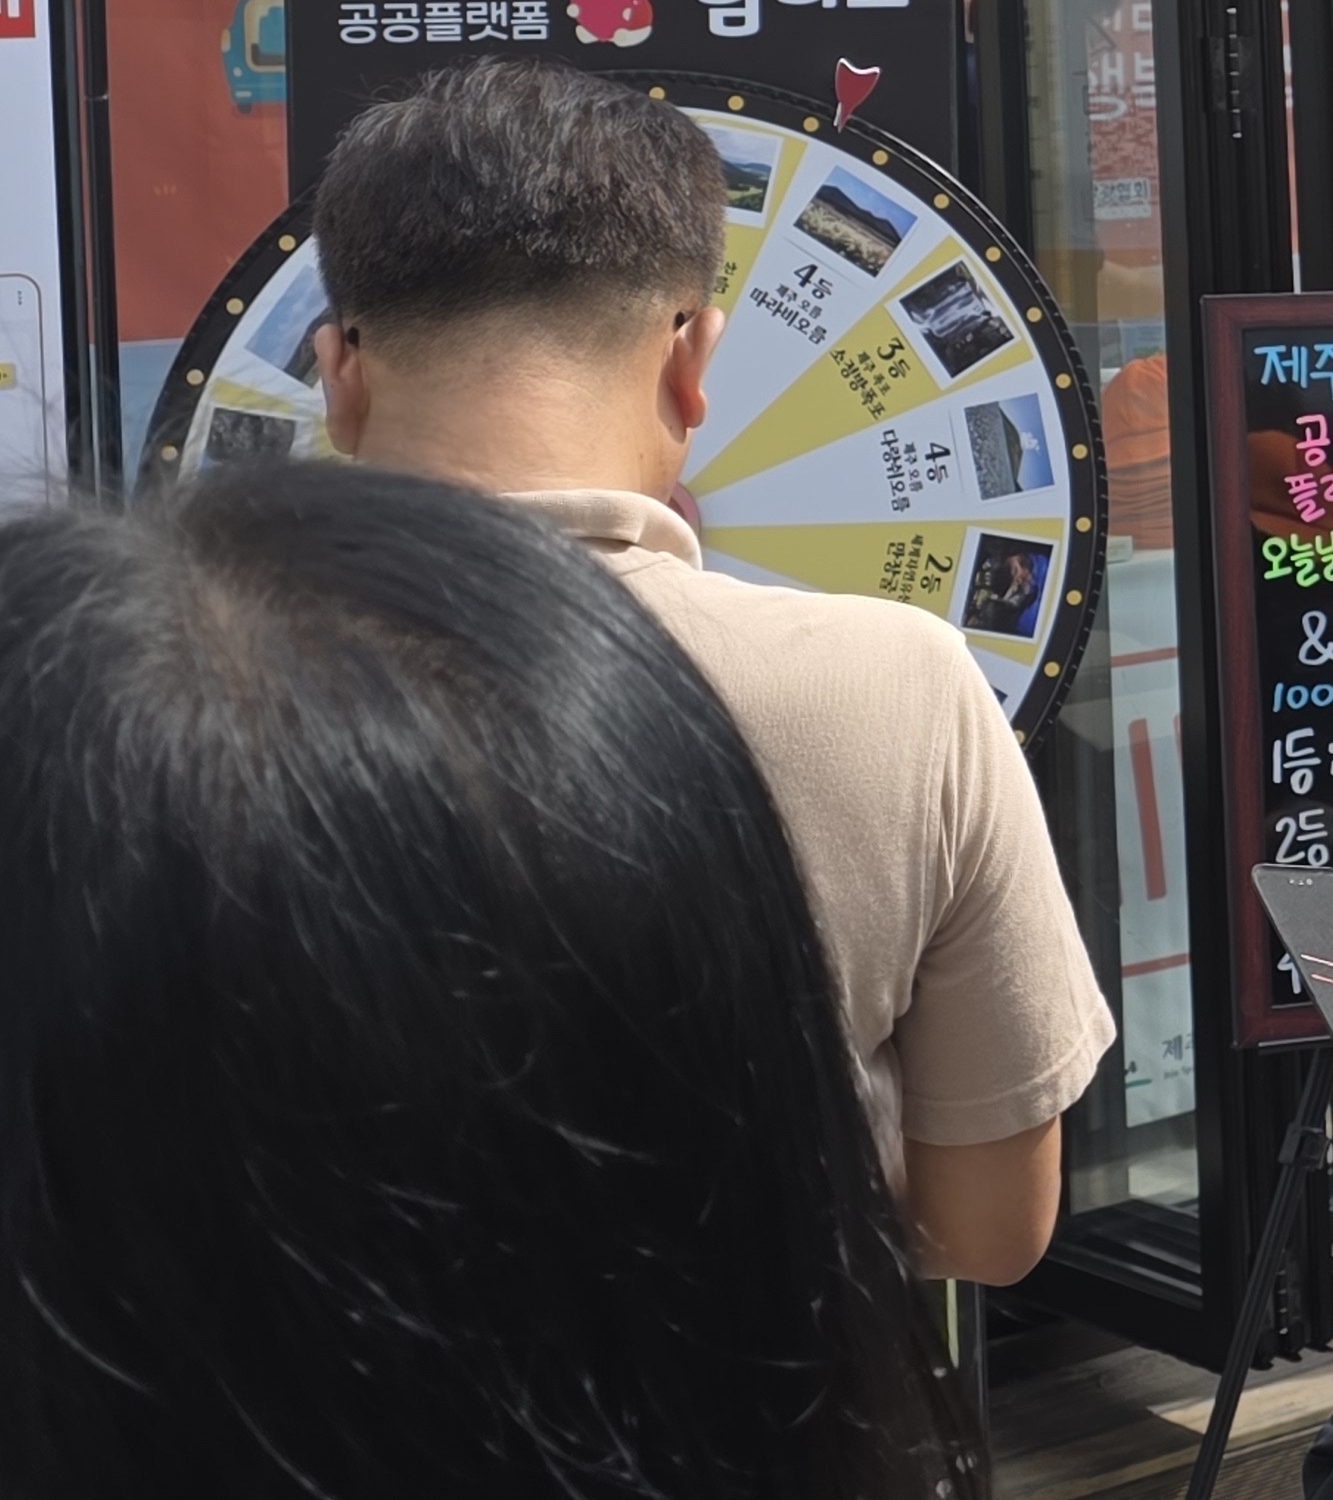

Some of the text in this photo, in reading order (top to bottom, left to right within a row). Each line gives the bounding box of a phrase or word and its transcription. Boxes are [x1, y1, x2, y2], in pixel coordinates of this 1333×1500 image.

[338, 1, 550, 44] 공공플랫폼
[793, 263, 834, 300] 4등
[749, 287, 828, 345] 따라비오름
[876, 337, 911, 380] 3등
[829, 349, 886, 422] 소정방폭포
[880, 429, 911, 513] 다랑쉬오름
[924, 441, 951, 484] 4등
[878, 541, 907, 595] 만장굴
[920, 552, 953, 595] 2등
